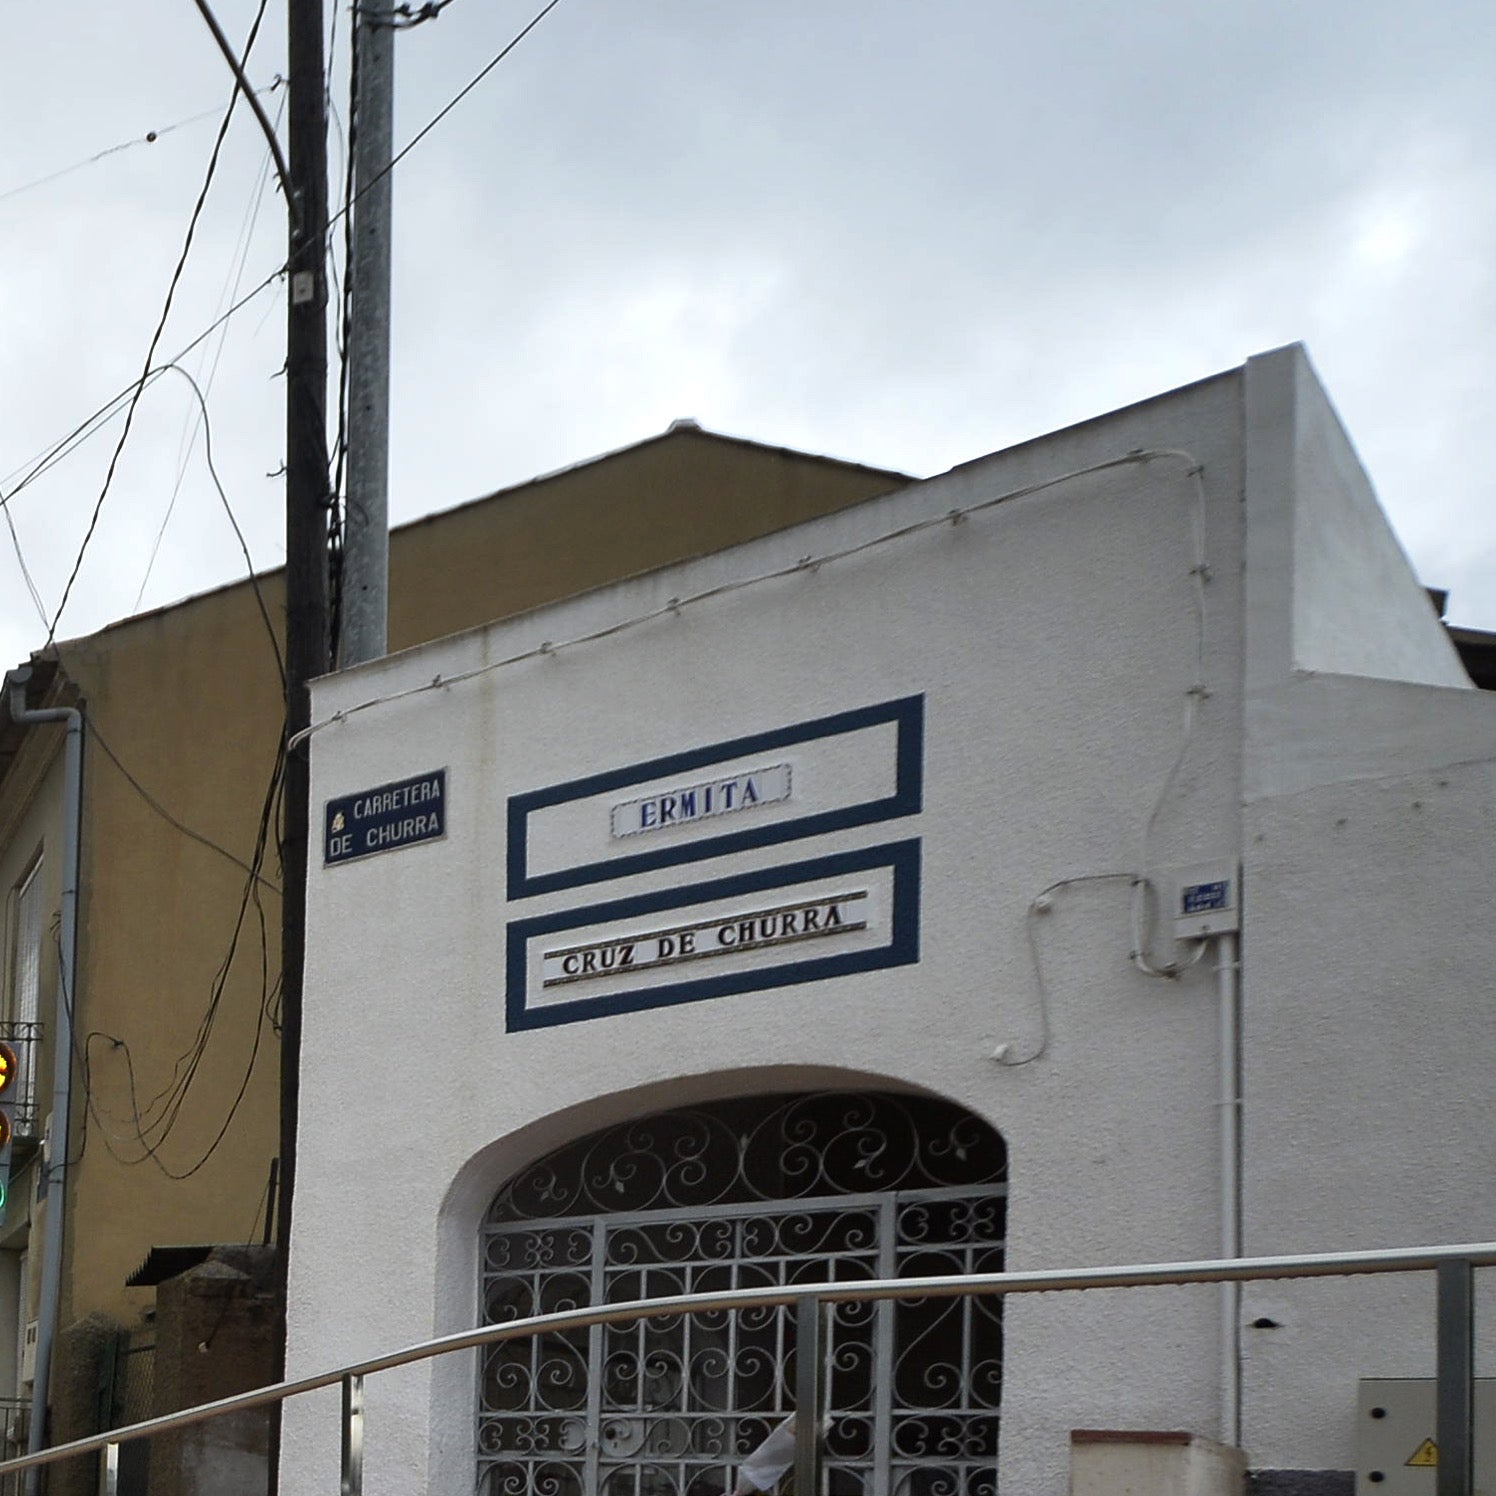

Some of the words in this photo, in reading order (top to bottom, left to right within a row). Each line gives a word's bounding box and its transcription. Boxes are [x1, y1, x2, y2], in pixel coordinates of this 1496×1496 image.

[354, 779, 440, 819] CARRETERA
[640, 778, 760, 828] ERMITA
[330, 834, 353, 856] DE
[366, 812, 439, 847] CHURRA
[562, 943, 635, 975] CRUZ
[658, 934, 696, 958] DE
[718, 904, 843, 946] CHURRA
